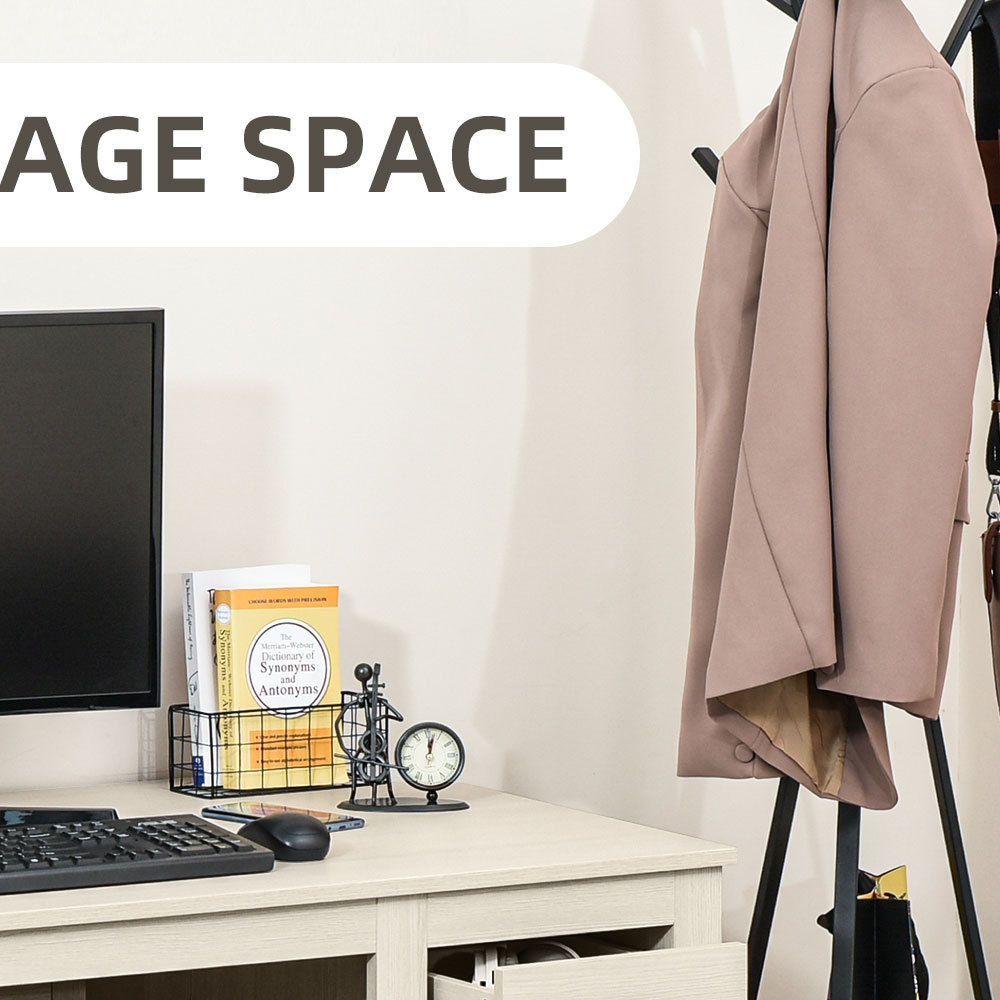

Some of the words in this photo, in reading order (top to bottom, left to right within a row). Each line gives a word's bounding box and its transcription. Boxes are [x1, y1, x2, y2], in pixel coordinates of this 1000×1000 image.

[261, 642, 314, 650] Merriam-Webster
[217, 629, 227, 681] Synonyms
[261, 651, 303, 662] Dictionary
[306, 650, 315, 660] of
[260, 661, 316, 675] Synonyms
[280, 674, 296, 684] and
[259, 684, 319, 698] Antonyms
